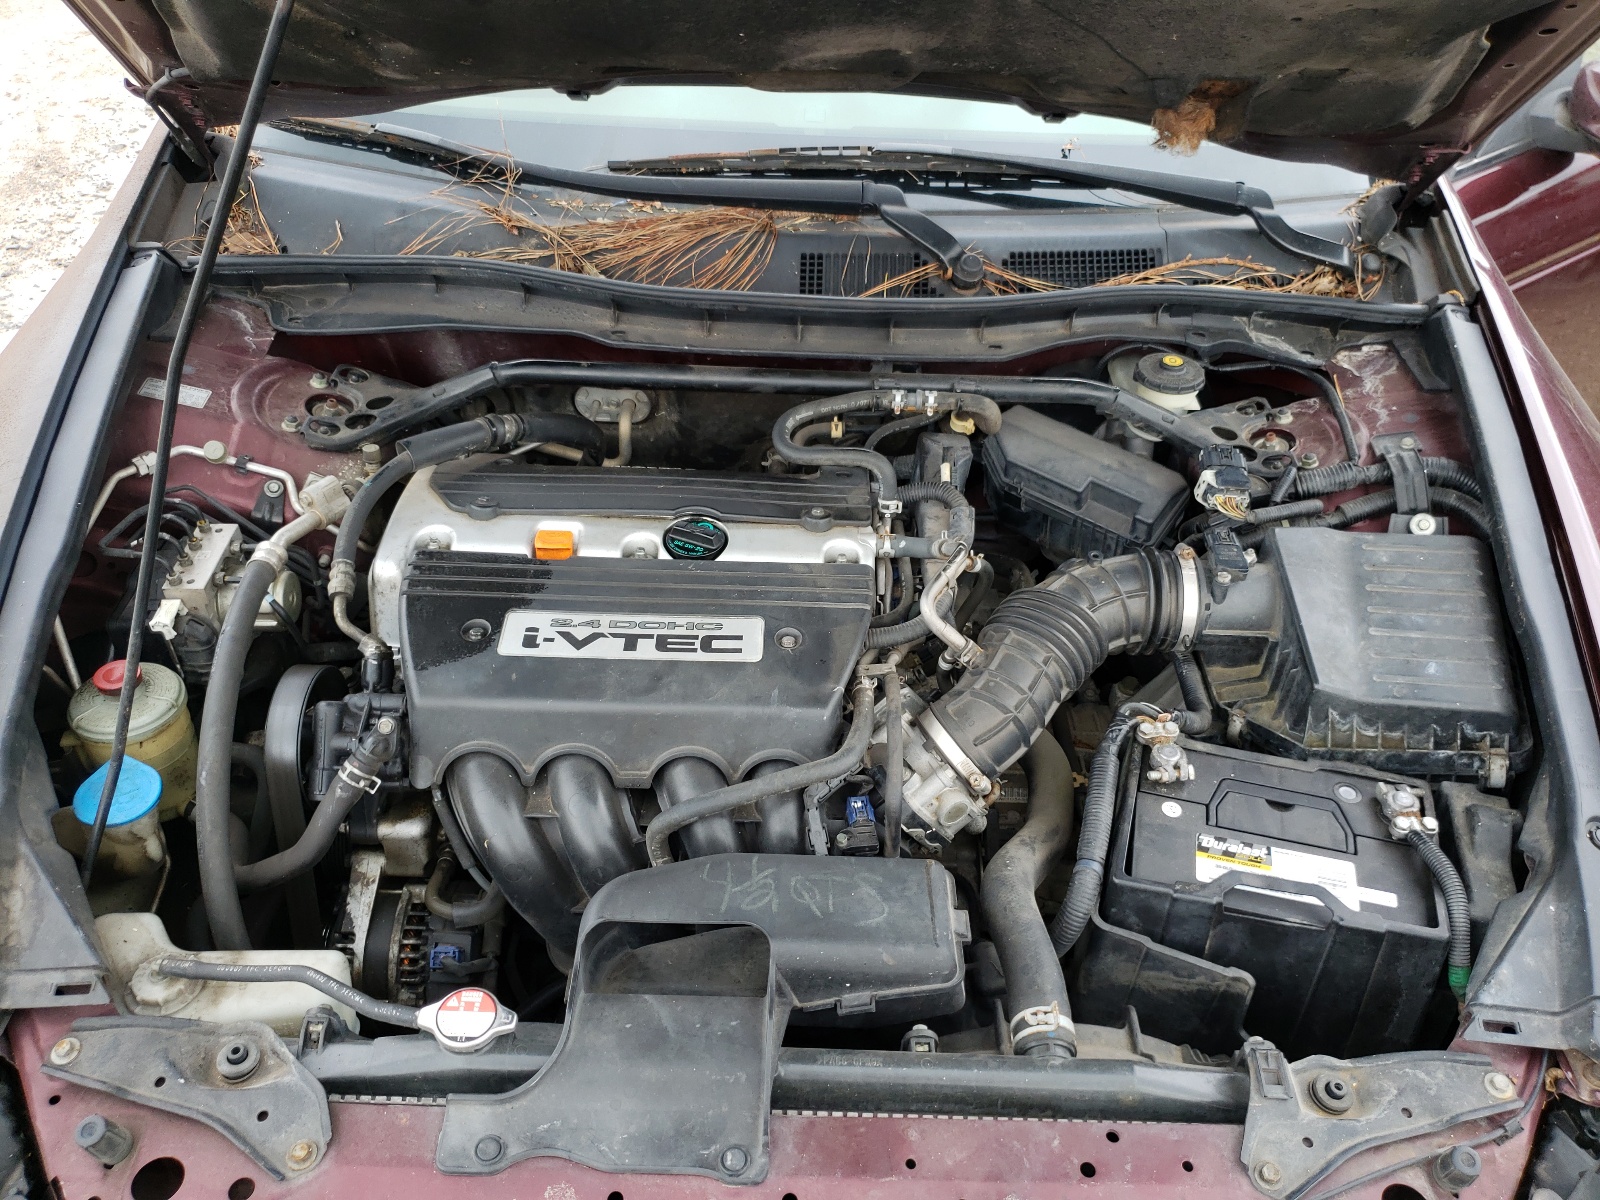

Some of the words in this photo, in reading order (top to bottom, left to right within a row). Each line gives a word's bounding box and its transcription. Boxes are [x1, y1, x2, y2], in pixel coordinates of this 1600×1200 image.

[550, 618, 602, 629] 2.4
[608, 619, 724, 631] DOHC
[521, 626, 744, 654] i-VTEC
[1199, 835, 1268, 859] Duralast
[1206, 854, 1236, 865] PROVEN
[1237, 860, 1262, 869] TOUGH
